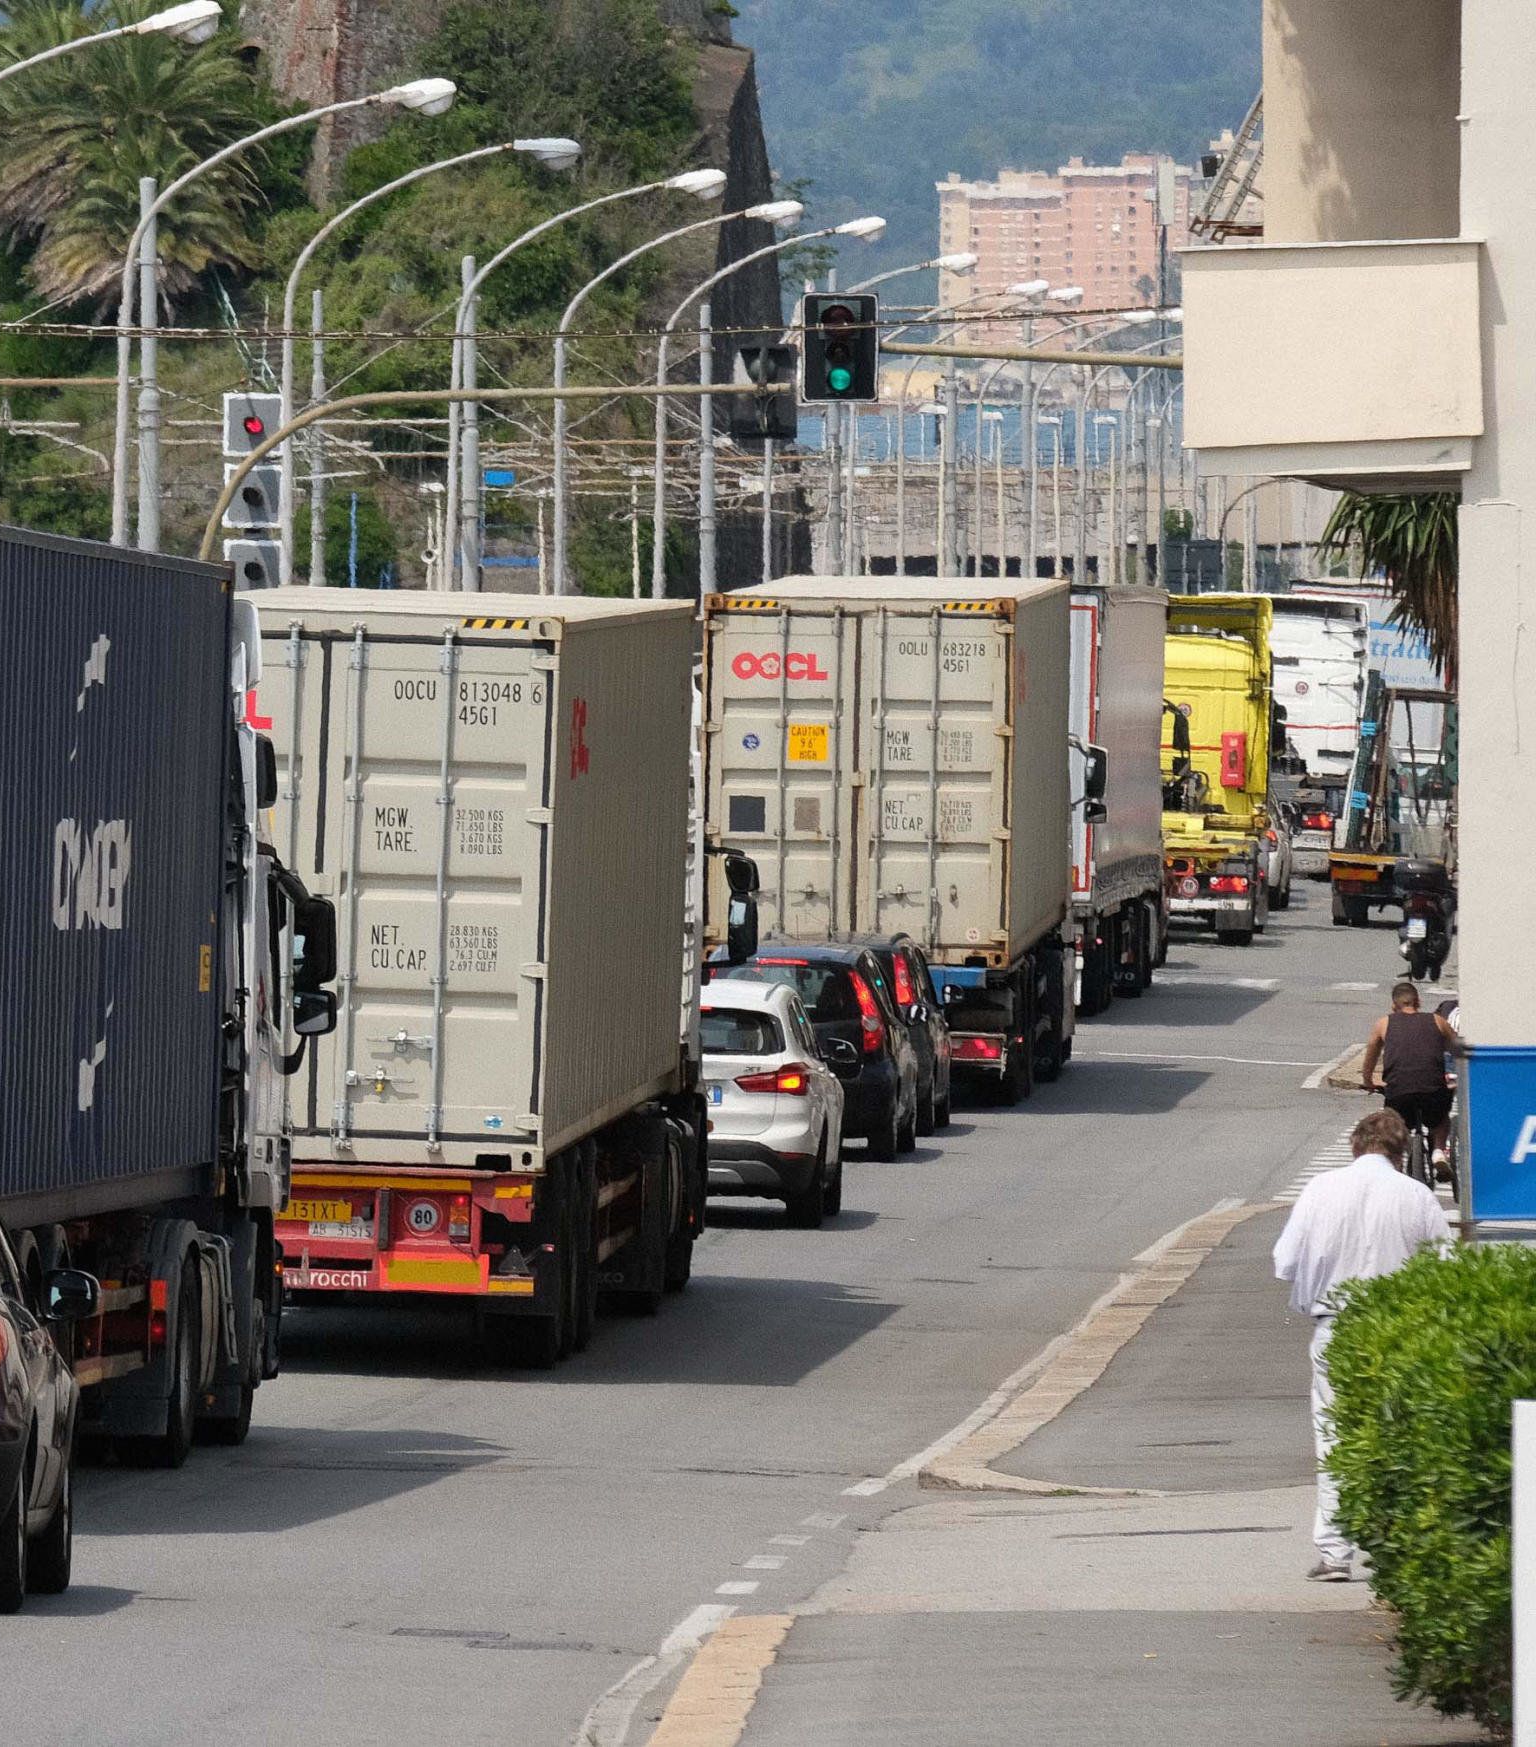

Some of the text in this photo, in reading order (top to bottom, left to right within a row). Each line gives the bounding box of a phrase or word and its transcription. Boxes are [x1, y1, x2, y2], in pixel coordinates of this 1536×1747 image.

[732, 652, 828, 680] OOCL
[943, 659, 969, 673] 45G1
[394, 680, 542, 703] OOCU 813048 6
[459, 706, 497, 726] 45G1
[375, 807, 413, 829] MGW.
[488, 822, 503, 832] LBS
[371, 925, 404, 946] NET.
[482, 938, 498, 949] LBS
[414, 1209, 433, 1225] 80
[284, 1270, 367, 1287] rocchi
